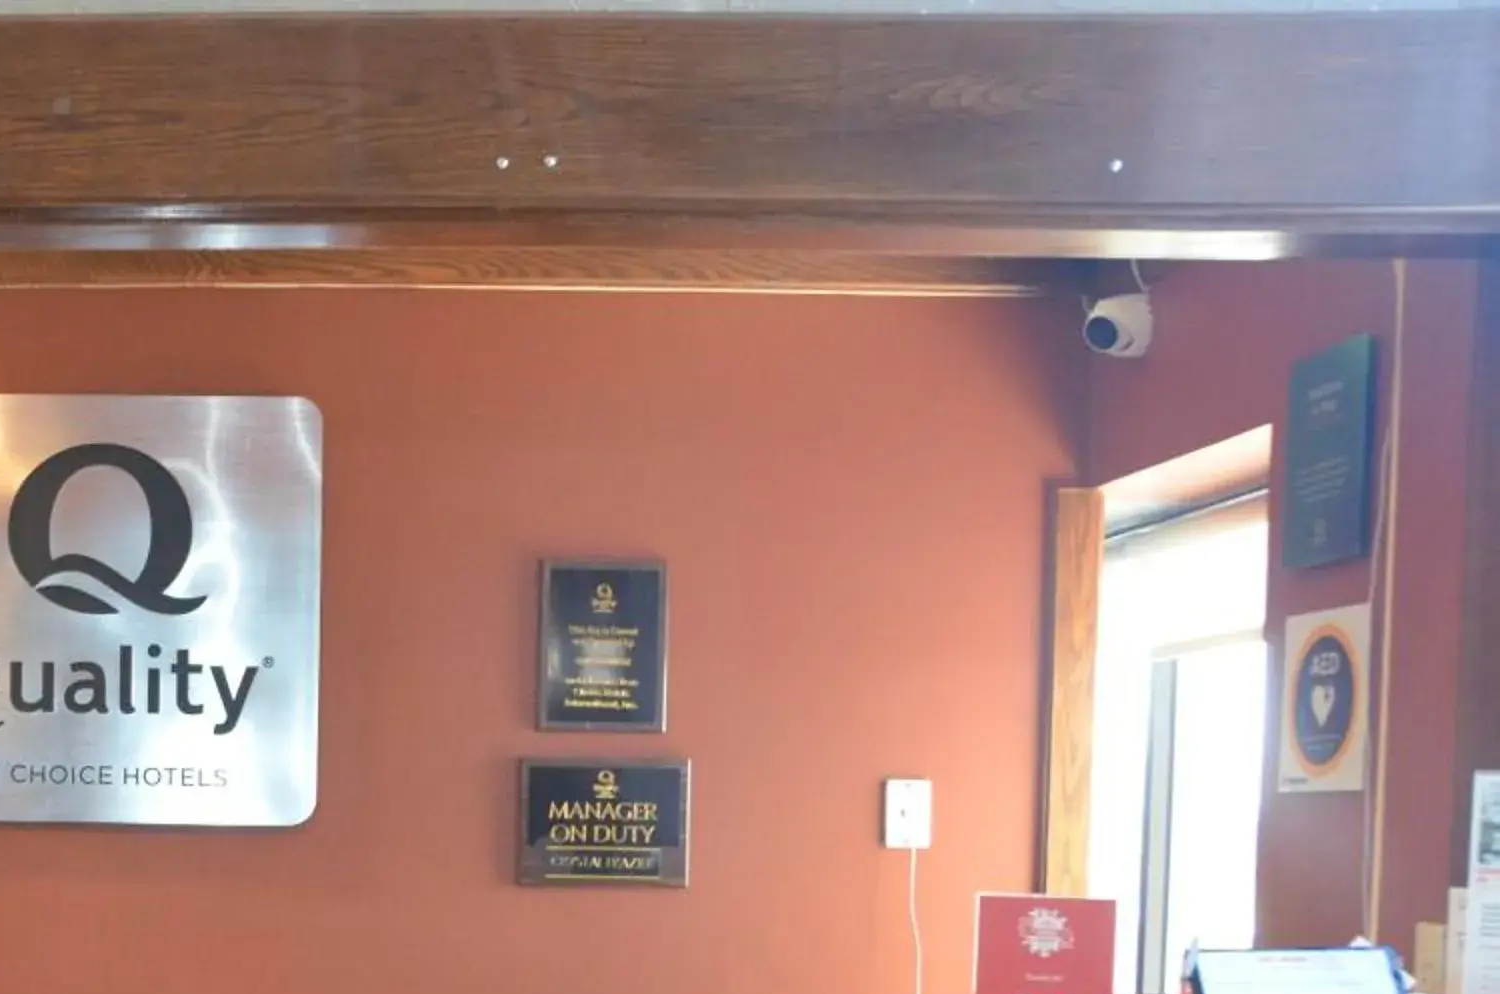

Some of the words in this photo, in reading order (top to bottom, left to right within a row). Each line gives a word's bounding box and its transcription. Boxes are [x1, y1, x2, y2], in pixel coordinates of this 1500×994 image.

[1310, 652, 1340, 676] AED
[10, 764, 113, 786] CHOICE
[123, 766, 228, 788] HOTELS
[548, 800, 657, 821] MANAGER
[550, 823, 587, 843] ON
[593, 824, 655, 844] DUTY
